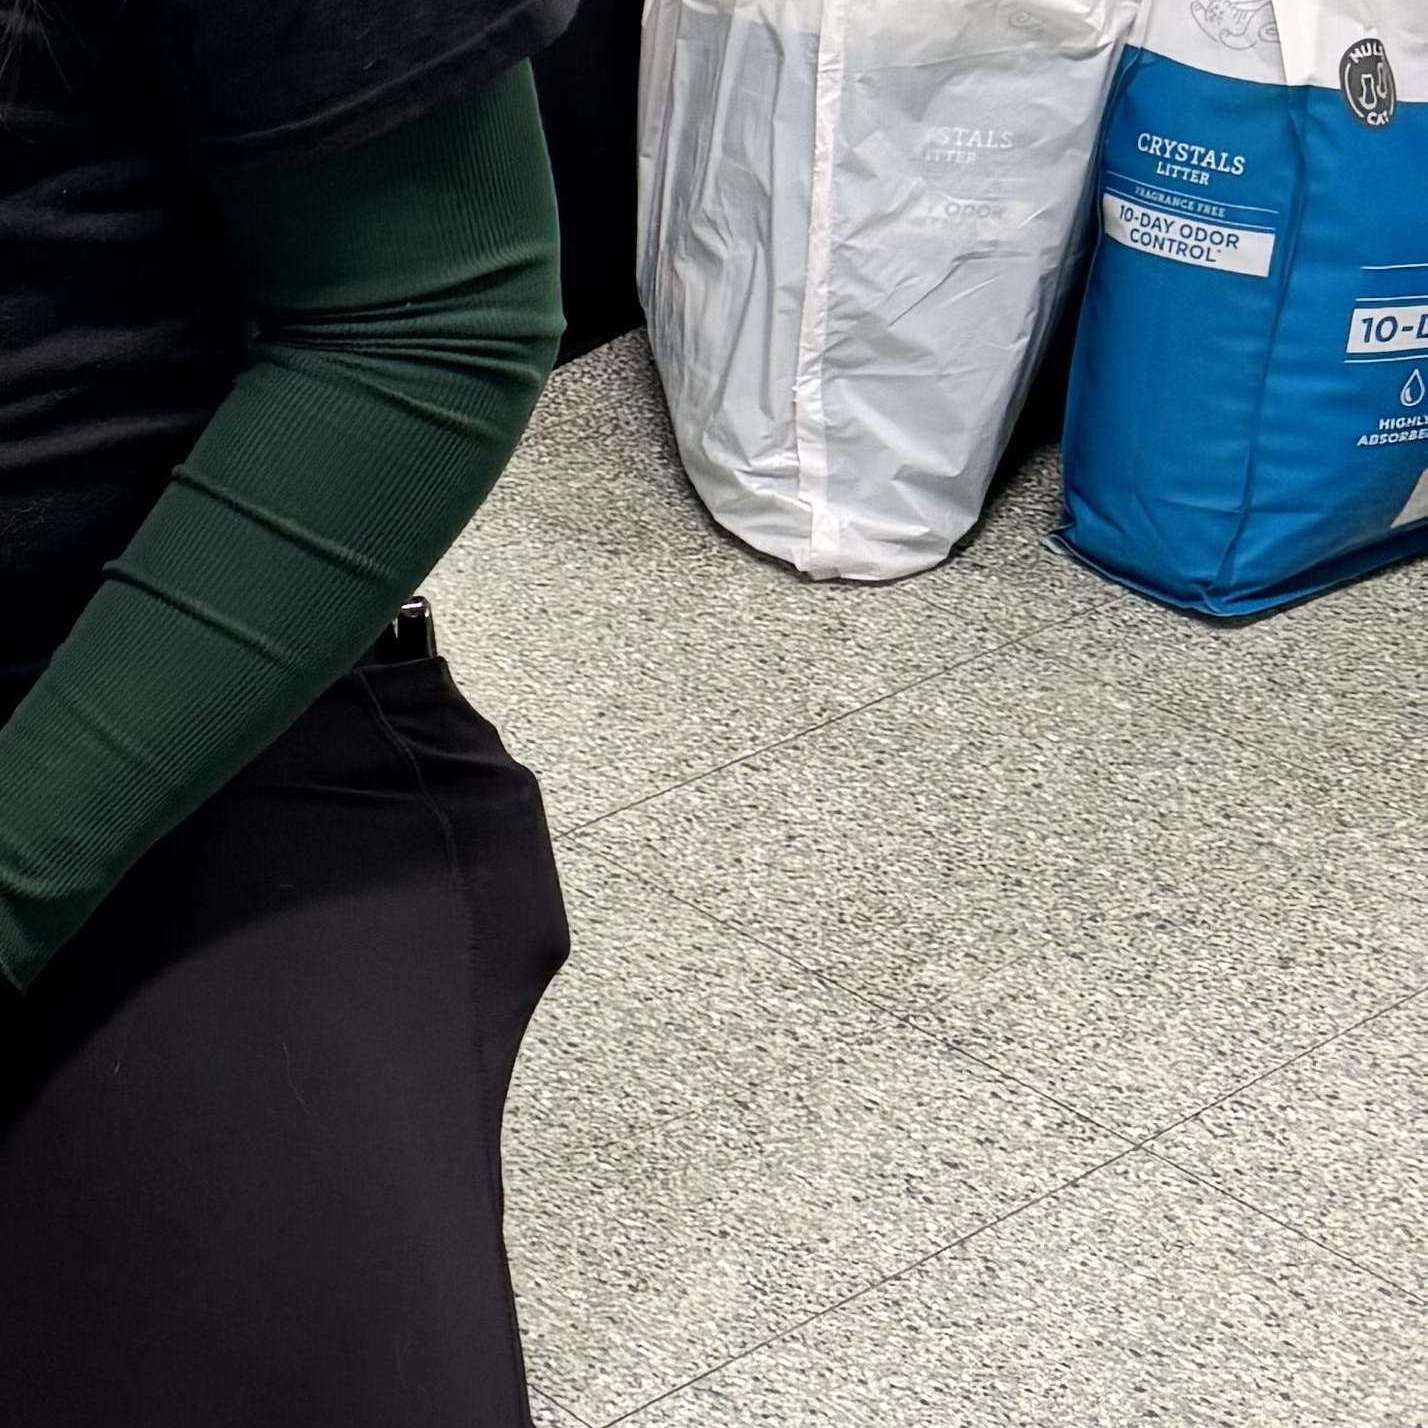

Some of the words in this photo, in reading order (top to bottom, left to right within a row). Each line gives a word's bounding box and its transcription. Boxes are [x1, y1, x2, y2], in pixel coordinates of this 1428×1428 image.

[1137, 132, 1246, 175] CRYSTALS
[1156, 161, 1210, 186] LITTER
[1119, 204, 1175, 234] 10-DAY
[1179, 223, 1240, 250] ODOR
[1197, 202, 1226, 218] FREE
